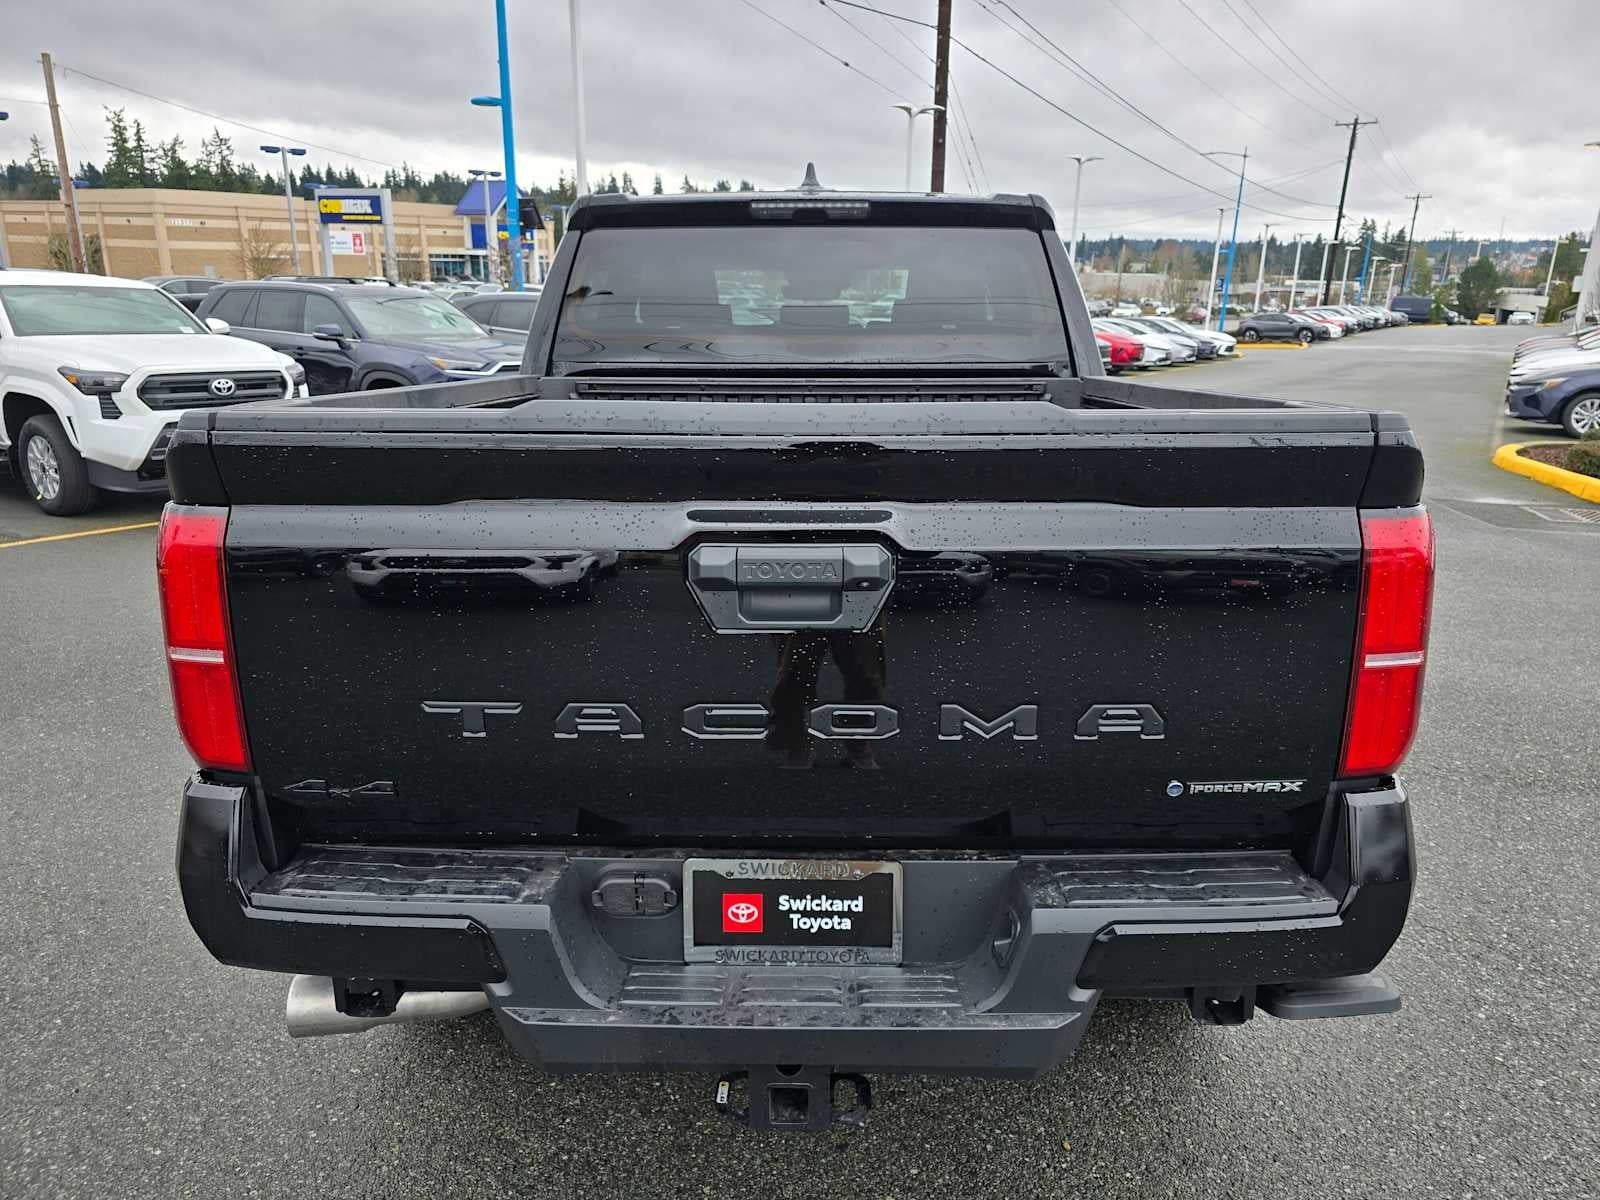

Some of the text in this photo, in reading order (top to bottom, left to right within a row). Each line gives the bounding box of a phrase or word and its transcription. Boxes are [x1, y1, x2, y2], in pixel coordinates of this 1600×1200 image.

[743, 562, 839, 579] TOYOTA
[421, 701, 1166, 740] TACOMA
[738, 861, 850, 878] SWICKARD
[778, 895, 864, 912] Swickard
[789, 914, 852, 933] Toyota
